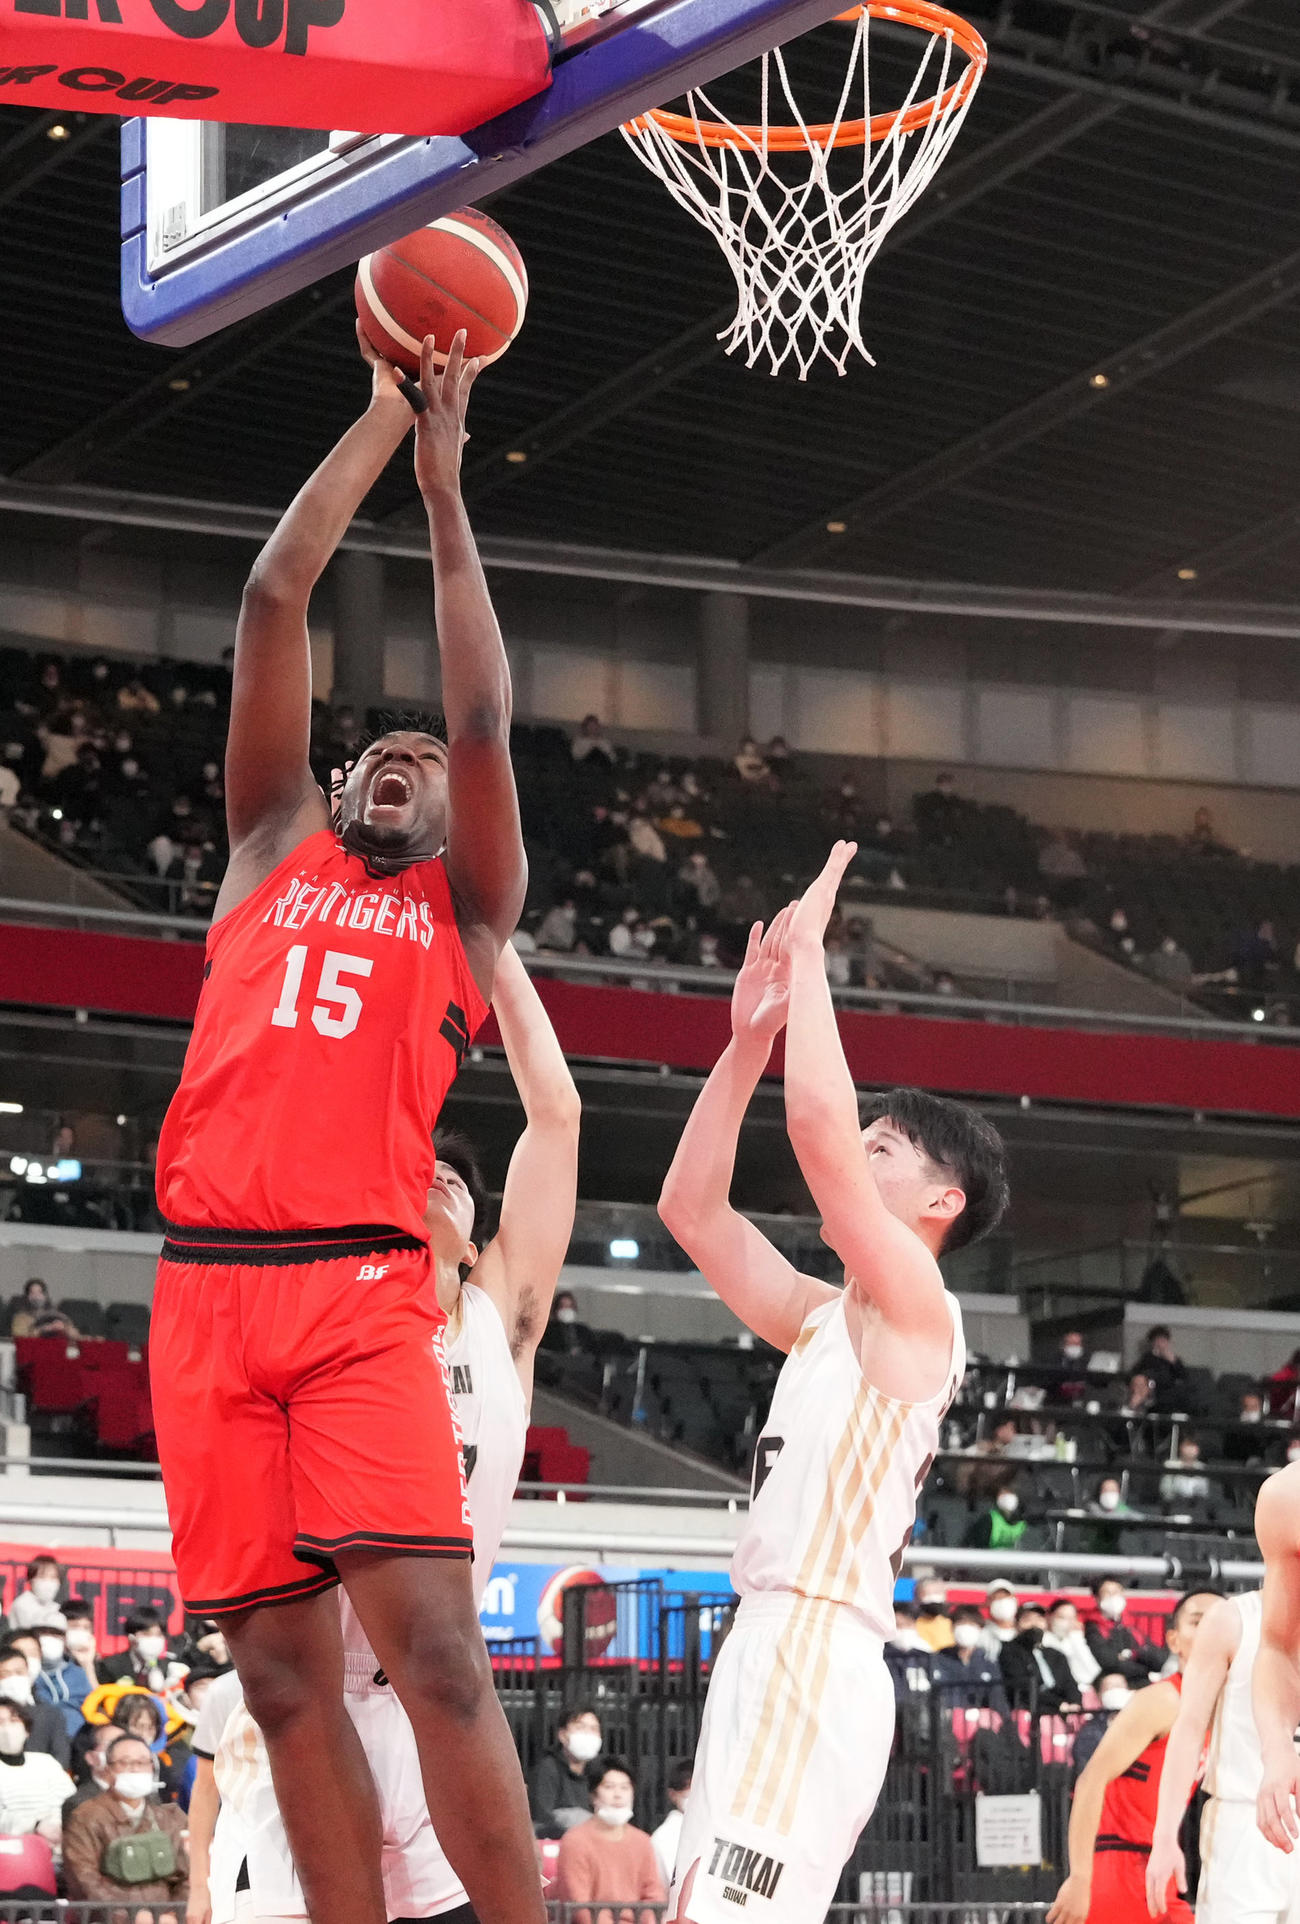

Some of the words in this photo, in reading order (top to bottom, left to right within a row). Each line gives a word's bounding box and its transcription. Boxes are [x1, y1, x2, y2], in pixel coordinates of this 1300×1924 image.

[58, 67, 220, 105] CUP
[271, 945, 374, 1039] 15
[708, 1837, 784, 1899] TOKAI
[722, 1886, 748, 1906] SUWA
